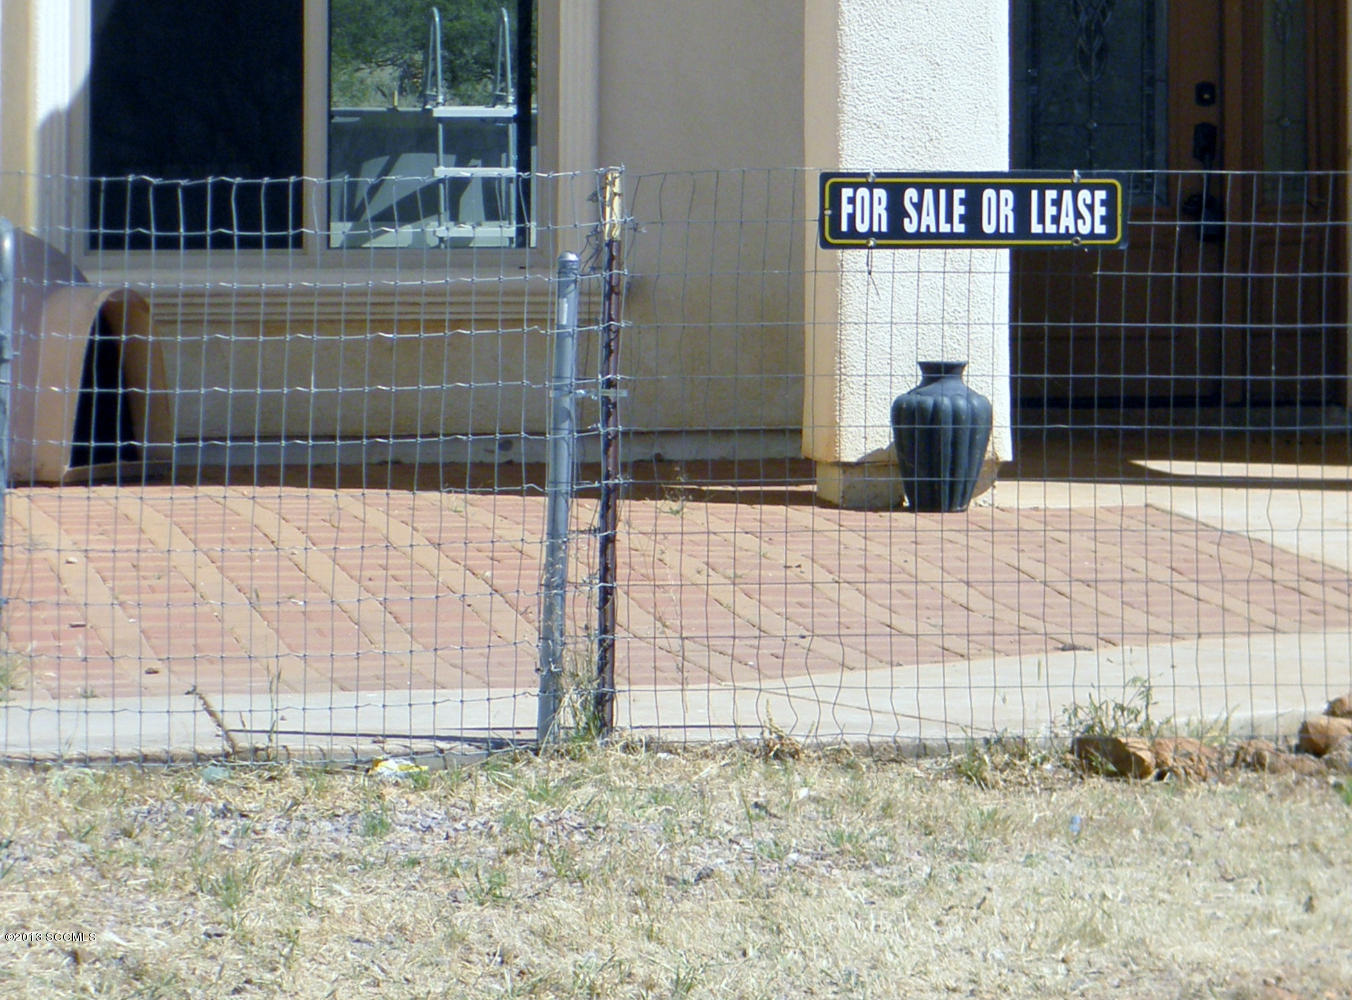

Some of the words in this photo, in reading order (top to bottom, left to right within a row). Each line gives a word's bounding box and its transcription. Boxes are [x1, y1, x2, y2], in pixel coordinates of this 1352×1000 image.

[840, 187, 888, 233] FOR
[903, 188, 966, 233] SALE
[981, 188, 1015, 234] OR
[1030, 189, 1107, 234] LEASE
